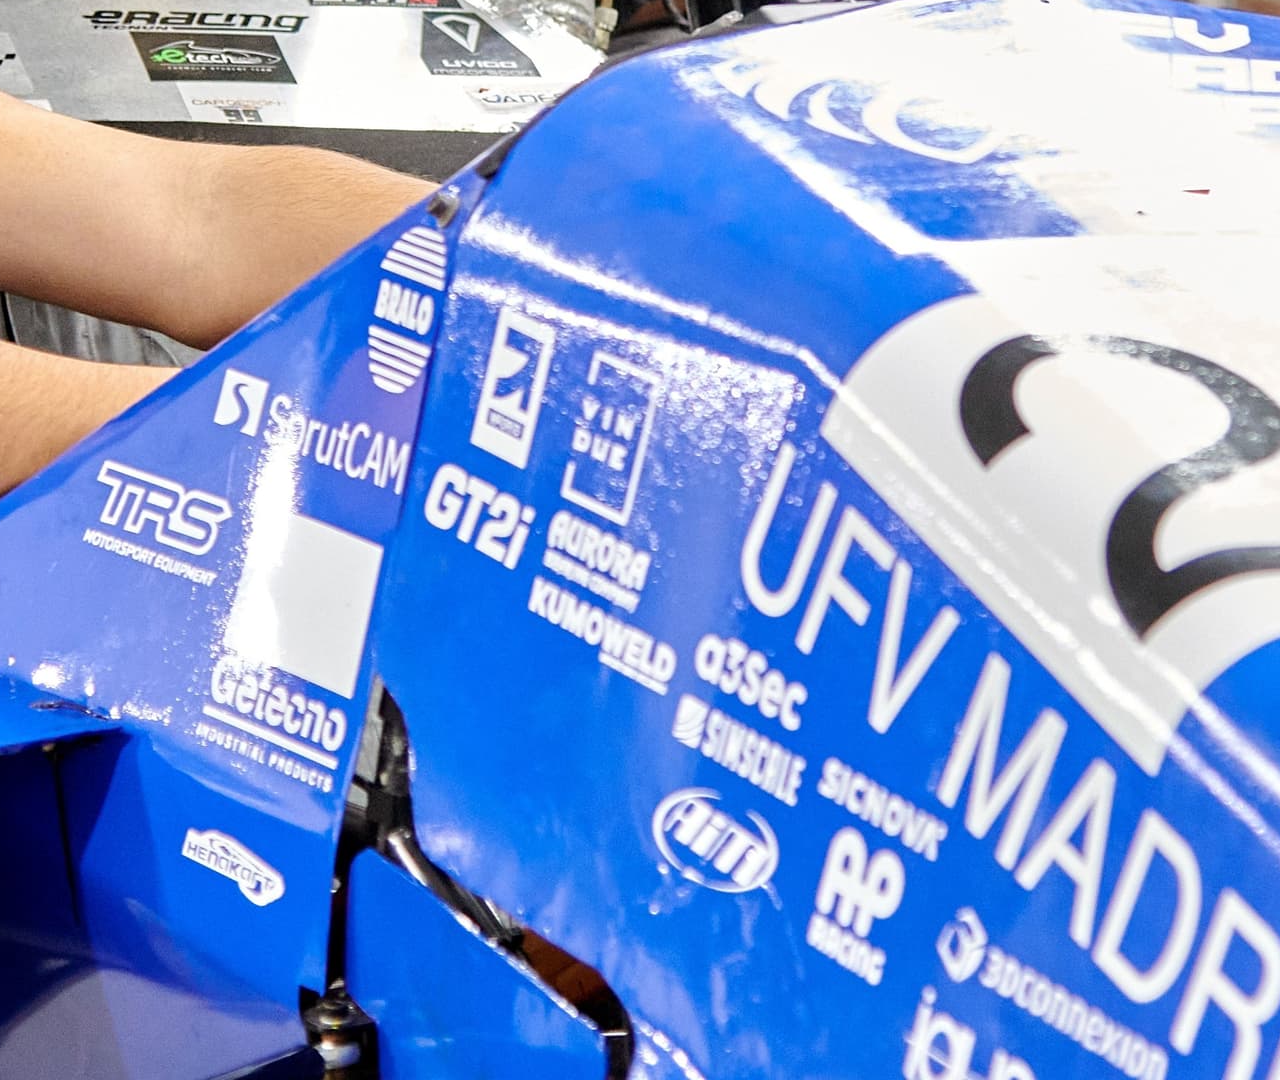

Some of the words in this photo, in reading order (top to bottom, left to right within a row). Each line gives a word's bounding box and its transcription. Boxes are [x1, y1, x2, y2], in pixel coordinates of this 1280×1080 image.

[374, 278, 435, 336] BRALO
[571, 426, 629, 472] DUE
[96, 459, 233, 556] TRS
[423, 462, 537, 571] GT2i
[82, 528, 156, 567] MOTORSPORT
[154, 552, 219, 588] EQUIPMENT
[546, 509, 652, 592] AURORA
[740, 441, 960, 733] UFV
[527, 574, 678, 684] KUMOWELD
[195, 721, 266, 765] INDUSTRIAL
[267, 751, 334, 794] PRODUCTS
